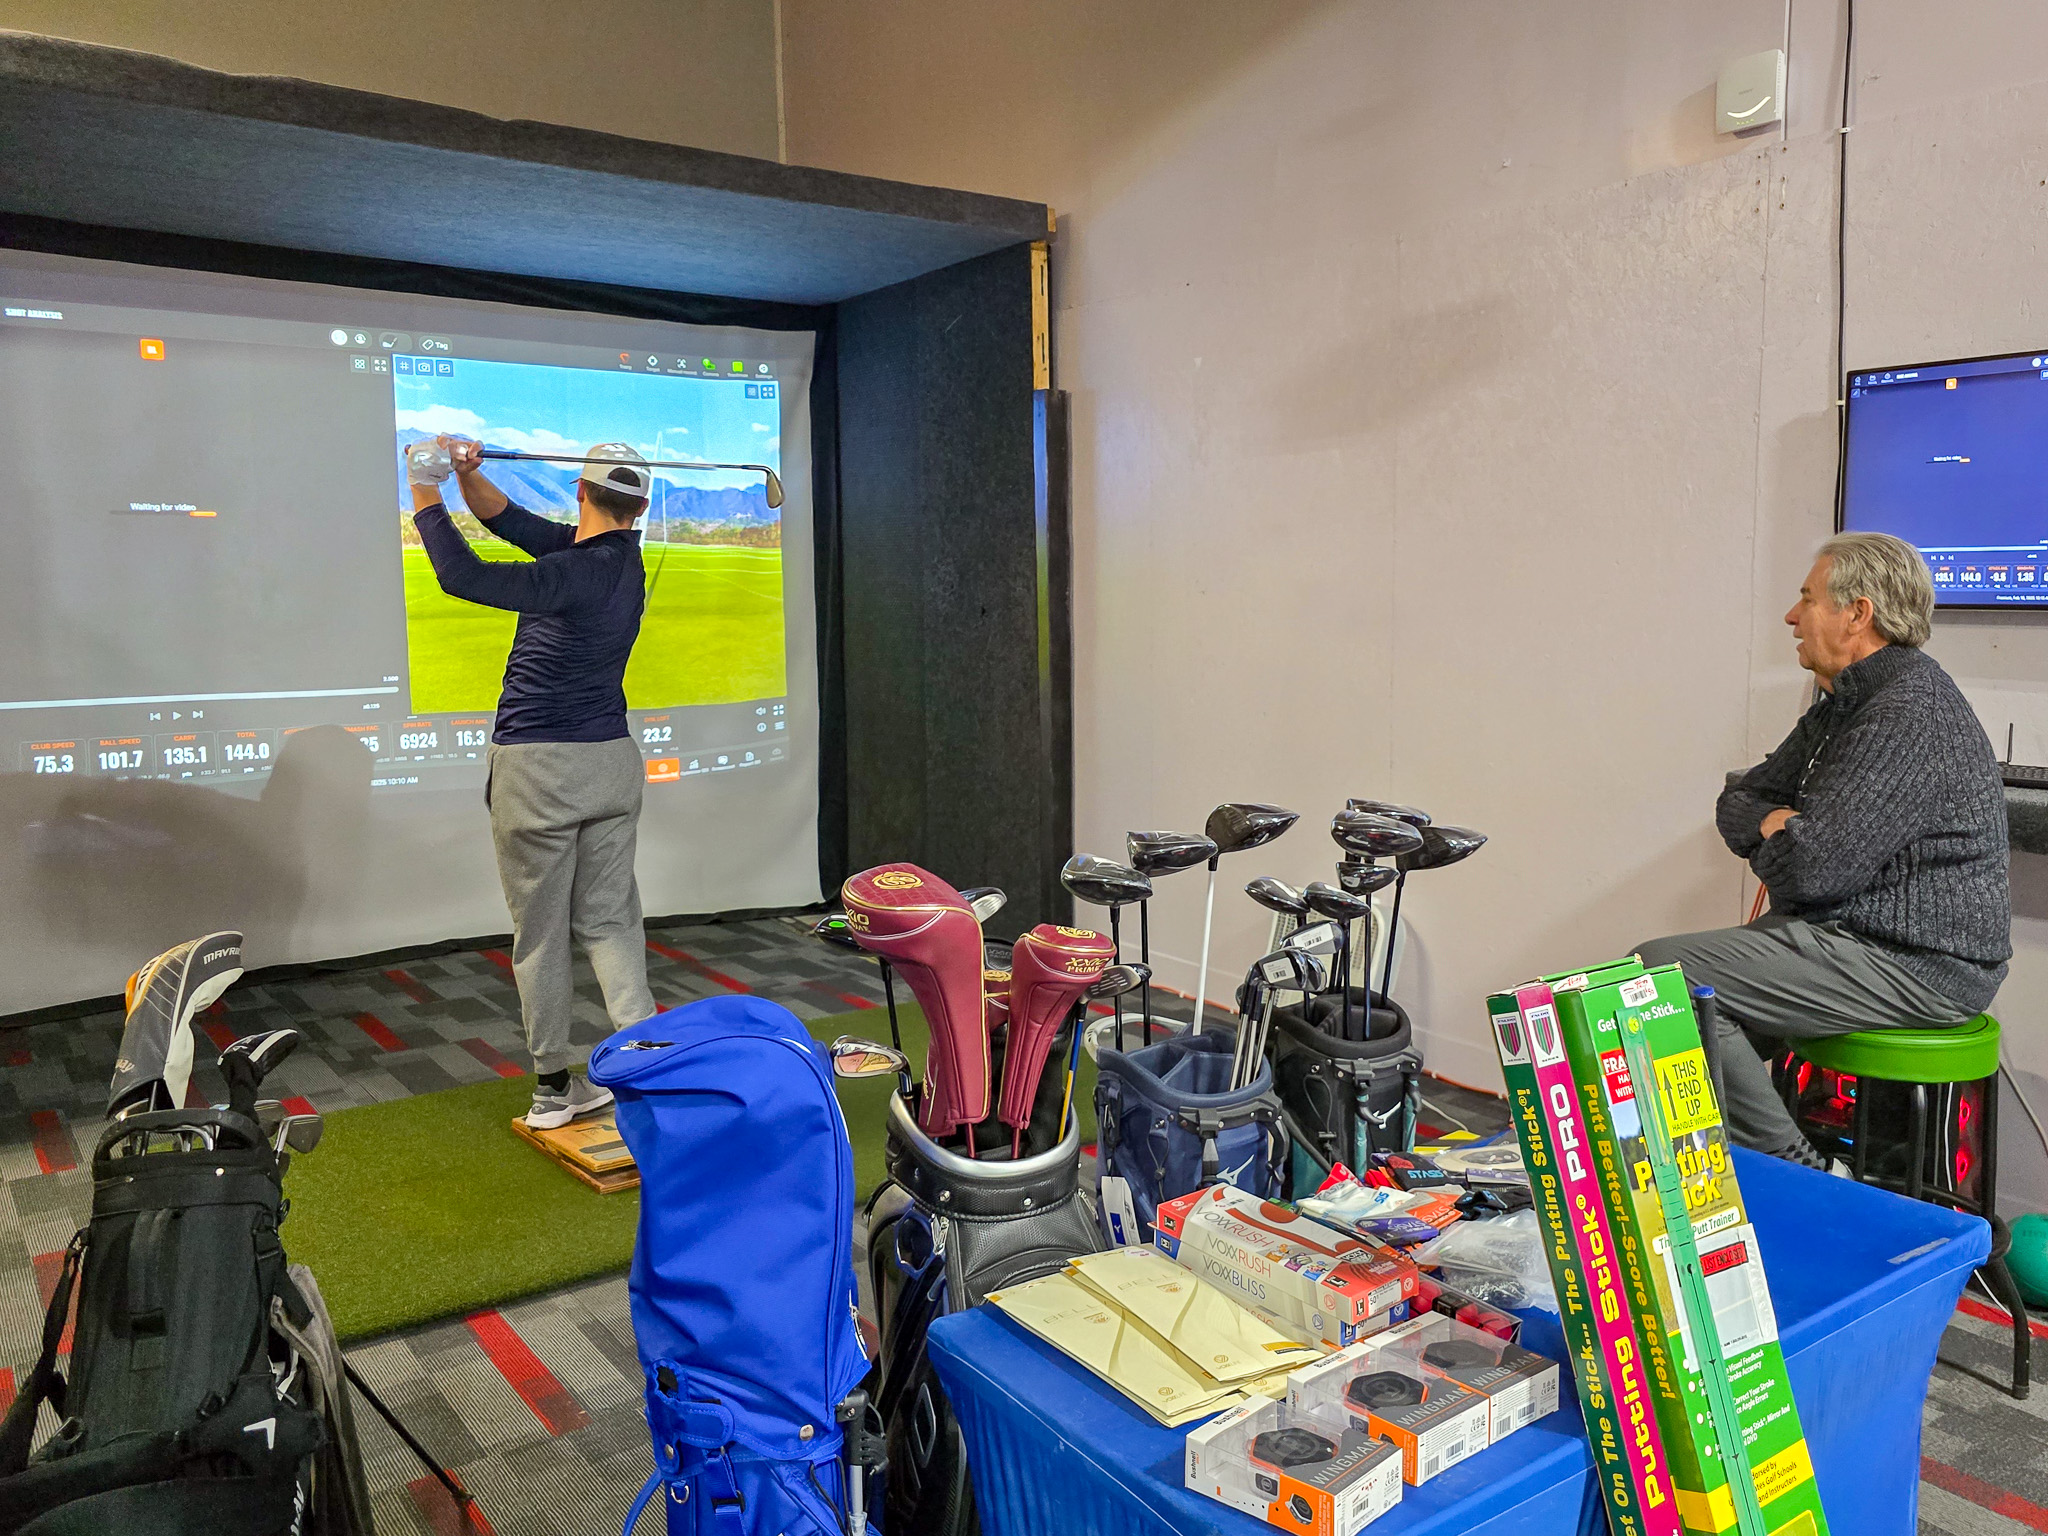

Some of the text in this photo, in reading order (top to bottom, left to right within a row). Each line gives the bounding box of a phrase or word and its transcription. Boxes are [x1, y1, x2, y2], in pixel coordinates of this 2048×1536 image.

[130, 503, 196, 512] Waiting for video
[173, 734, 197, 742] CARRY
[399, 732, 438, 750] 6924
[456, 730, 486, 747] 16.3
[643, 726, 672, 743] 23.2
[52, 741, 75, 749] SPEED
[225, 743, 270, 761] 144.0
[33, 755, 74, 774] 75.3
[98, 750, 143, 770] 101.7
[164, 746, 207, 765] 135.1
[387, 777, 406, 785] 10:10
[406, 776, 419, 784] AM
[1067, 965, 1100, 973] PRIME
[1597, 1017, 1617, 1033] Get
[1651, 1001, 1685, 1019] Stick...
[1602, 1054, 1628, 1074] FRA
[1671, 1059, 1698, 1080] THIS
[1615, 1085, 1634, 1098] WITH
[1677, 1079, 1702, 1100] END
[1686, 1098, 1701, 1117] UP
[1671, 1112, 1720, 1132] HANDLE WITH CAR
[1549, 1083, 1587, 1182] PRO
[1633, 1141, 1726, 1194] Pting
[1196, 1206, 1275, 1248] VOXXRUSH
[1541, 1174, 1571, 1261] Putting
[1692, 1223, 1709, 1236] Putt
[1708, 1211, 1735, 1229] Trainer
[1583, 1084, 1607, 1133] Putt
[1641, 1313, 1677, 1400] Better!
[1207, 1232, 1271, 1279] VOXXRUSH
[1703, 1255, 1716, 1271] LIST
[1203, 1254, 1266, 1300] VOXXBLISS
[1564, 1268, 1583, 1315] The
[1389, 1320, 1420, 1334] Bushnell
[1313, 1352, 1347, 1369] Bushnell
[1742, 1348, 1765, 1365] Feedback
[1469, 1353, 1540, 1387] WINGMAN
[1742, 1361, 1762, 1377] Accuracy
[1749, 1385, 1760, 1397] Your
[1759, 1378, 1775, 1391] Stroke
[1397, 1387, 1469, 1426] WINGMAN
[1742, 1398, 1756, 1411] Angle
[1755, 1392, 1769, 1404] Errors
[1212, 1406, 1246, 1426] Bushnell
[1614, 1335, 1666, 1509] Putting
[1766, 1409, 1781, 1423] Mirror
[1780, 1403, 1791, 1414] And
[1599, 1417, 1619, 1465] The
[1746, 1433, 1758, 1445] DVD
[1309, 1440, 1381, 1485] WINGMAN
[1770, 1460, 1777, 1471] by
[1765, 1475, 1777, 1488] Golf
[1777, 1461, 1797, 1479] Schools
[1612, 1472, 1629, 1507] On
[1769, 1475, 1797, 1498] Instructors
